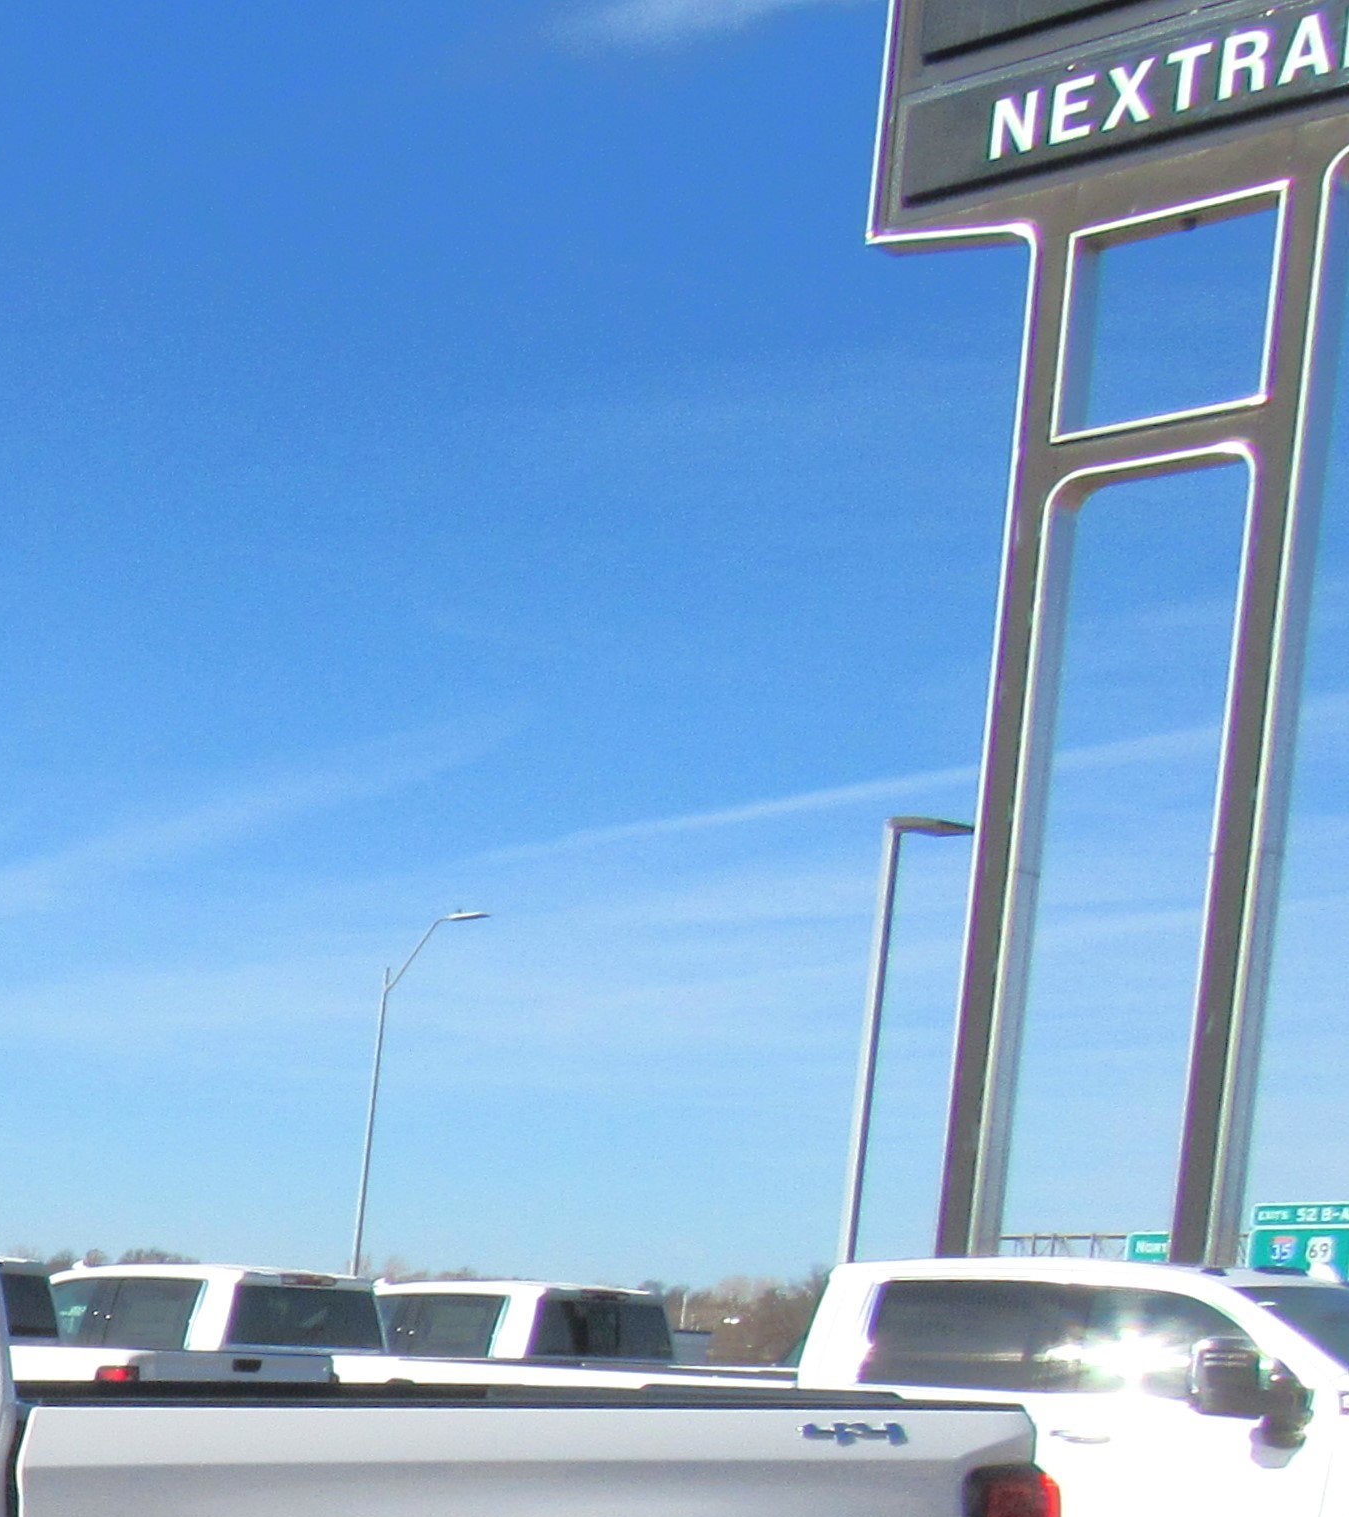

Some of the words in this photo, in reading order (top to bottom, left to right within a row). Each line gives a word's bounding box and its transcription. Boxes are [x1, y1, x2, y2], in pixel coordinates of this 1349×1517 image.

[987, 10, 1349, 161] NEXTRA
[1296, 1207, 1318, 1222] 52
[1270, 1243, 1293, 1260] 35
[1308, 1242, 1330, 1259] 69
